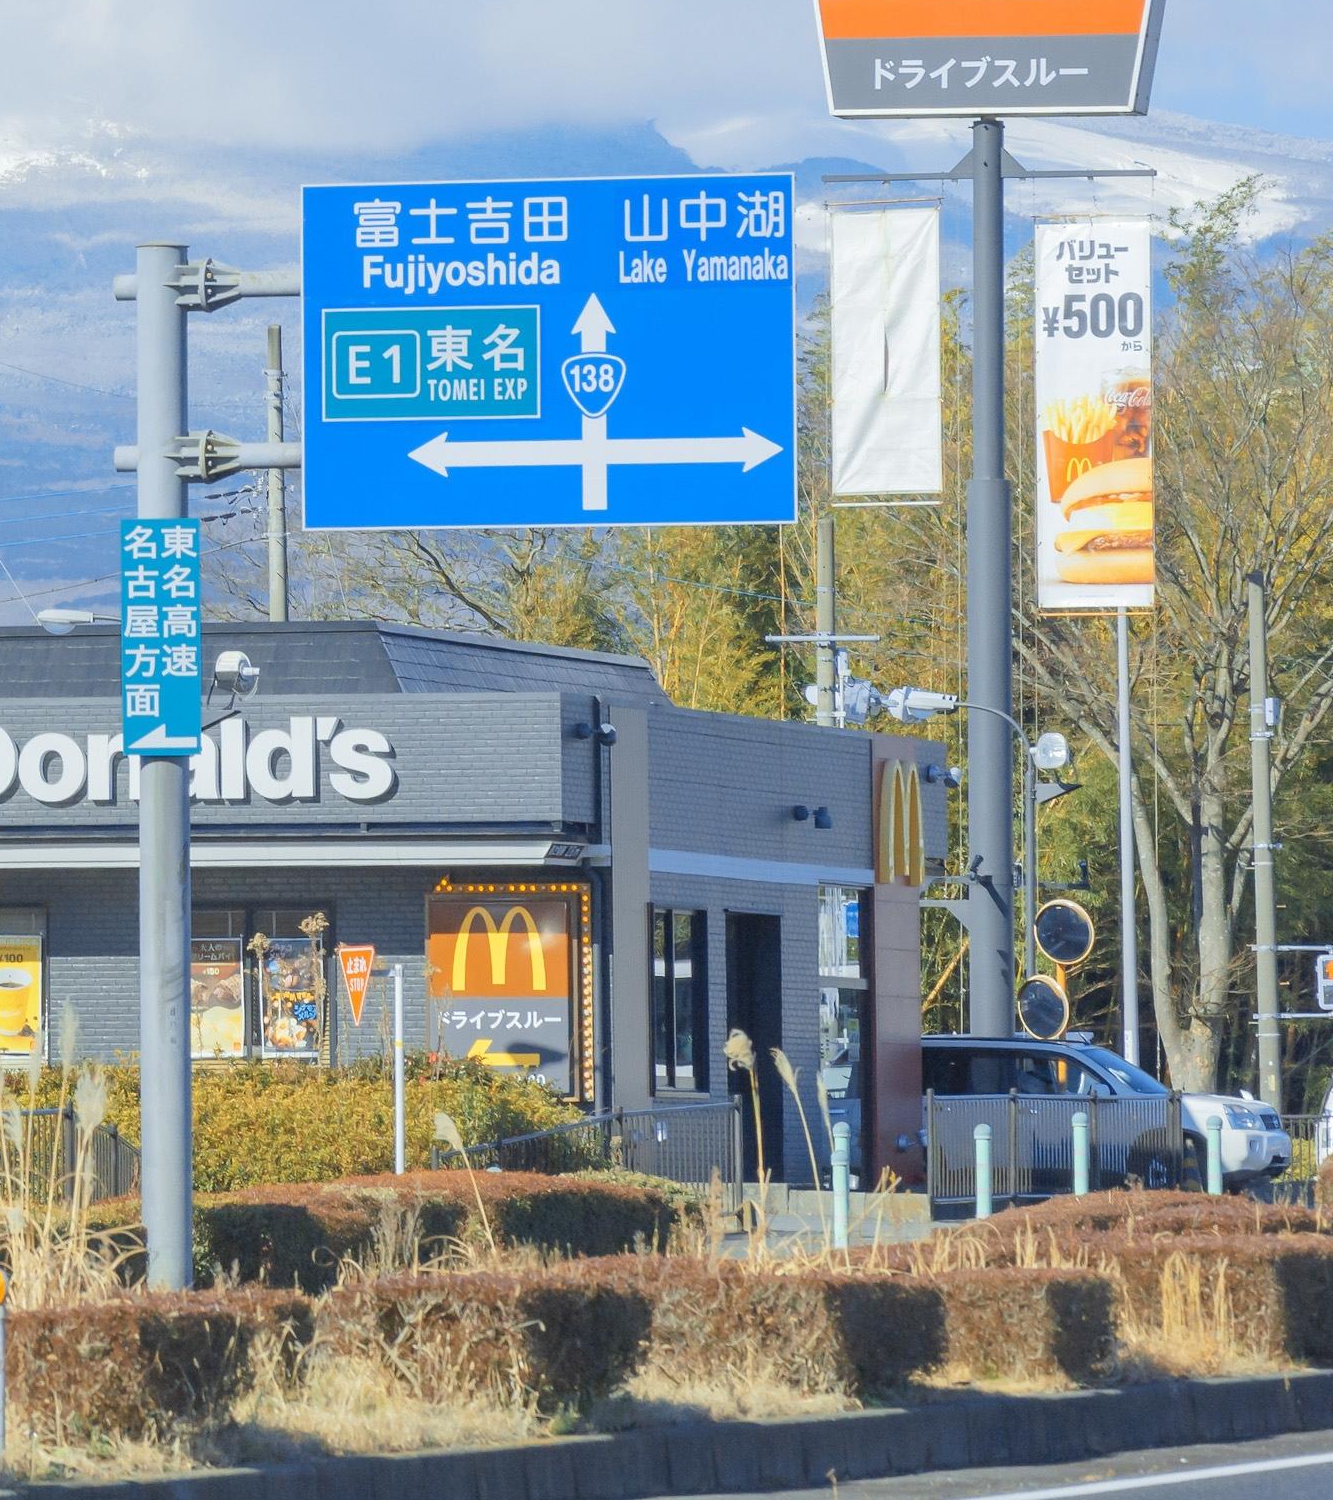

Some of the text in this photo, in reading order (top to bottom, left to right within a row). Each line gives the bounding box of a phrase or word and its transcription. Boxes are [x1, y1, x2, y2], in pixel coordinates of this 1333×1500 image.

[874, 56, 1089, 90] ドライブスルー
[353, 190, 785, 248] 富士吉田 山中湖
[619, 248, 788, 284] Lake Yamanaka
[1056, 240, 1129, 261] バリュー
[363, 252, 560, 294] Fujiyoshida
[1065, 263, 1119, 284] セット
[1042, 292, 1143, 339] ¥500
[427, 324, 525, 372] 東名
[1121, 341, 1143, 352] から
[428, 378, 528, 401] TOMEI EXP
[570, 364, 614, 393] 138
[161, 526, 197, 677] 東名高速
[124, 526, 161, 717] 名古屋方面
[346, 957, 367, 974] 止まれ
[350, 978, 364, 992] STOP
